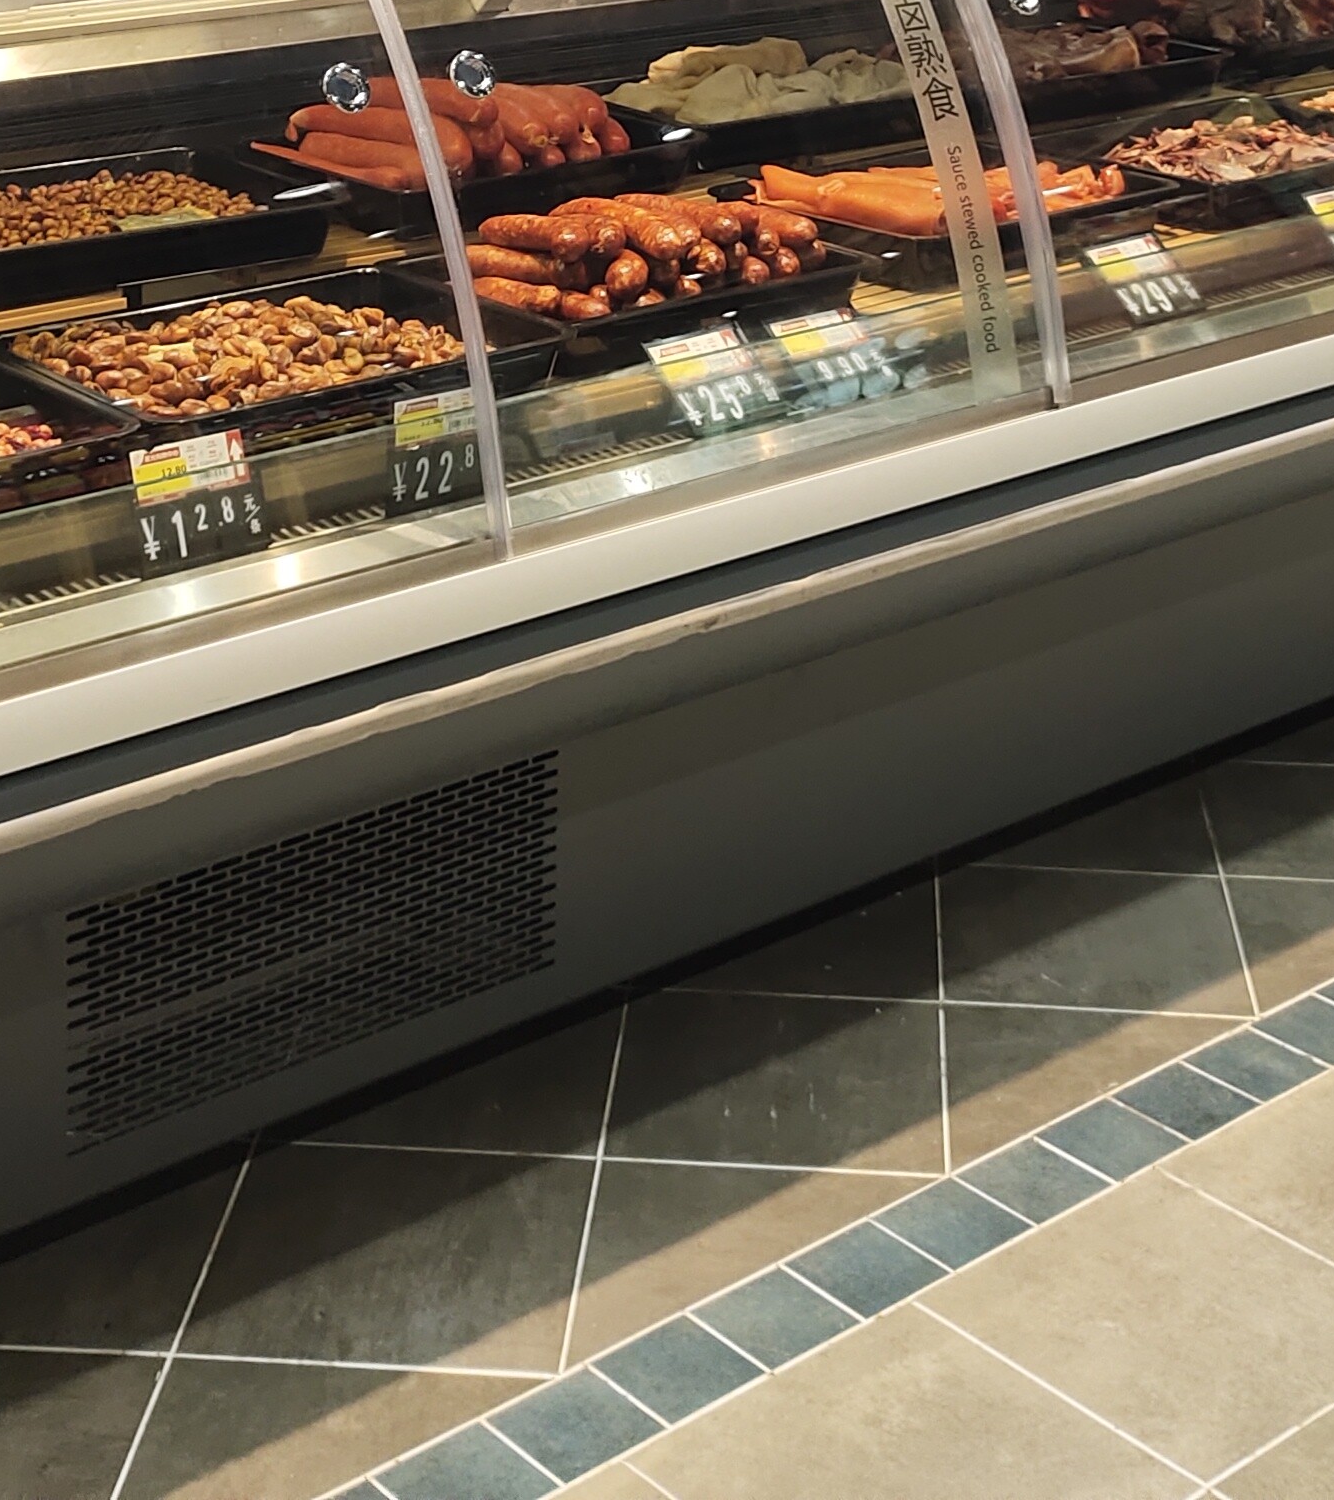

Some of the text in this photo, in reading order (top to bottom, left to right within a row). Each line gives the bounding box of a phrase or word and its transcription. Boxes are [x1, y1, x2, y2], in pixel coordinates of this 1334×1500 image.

[946, 145, 1000, 353] Sauce stewed cooked food
